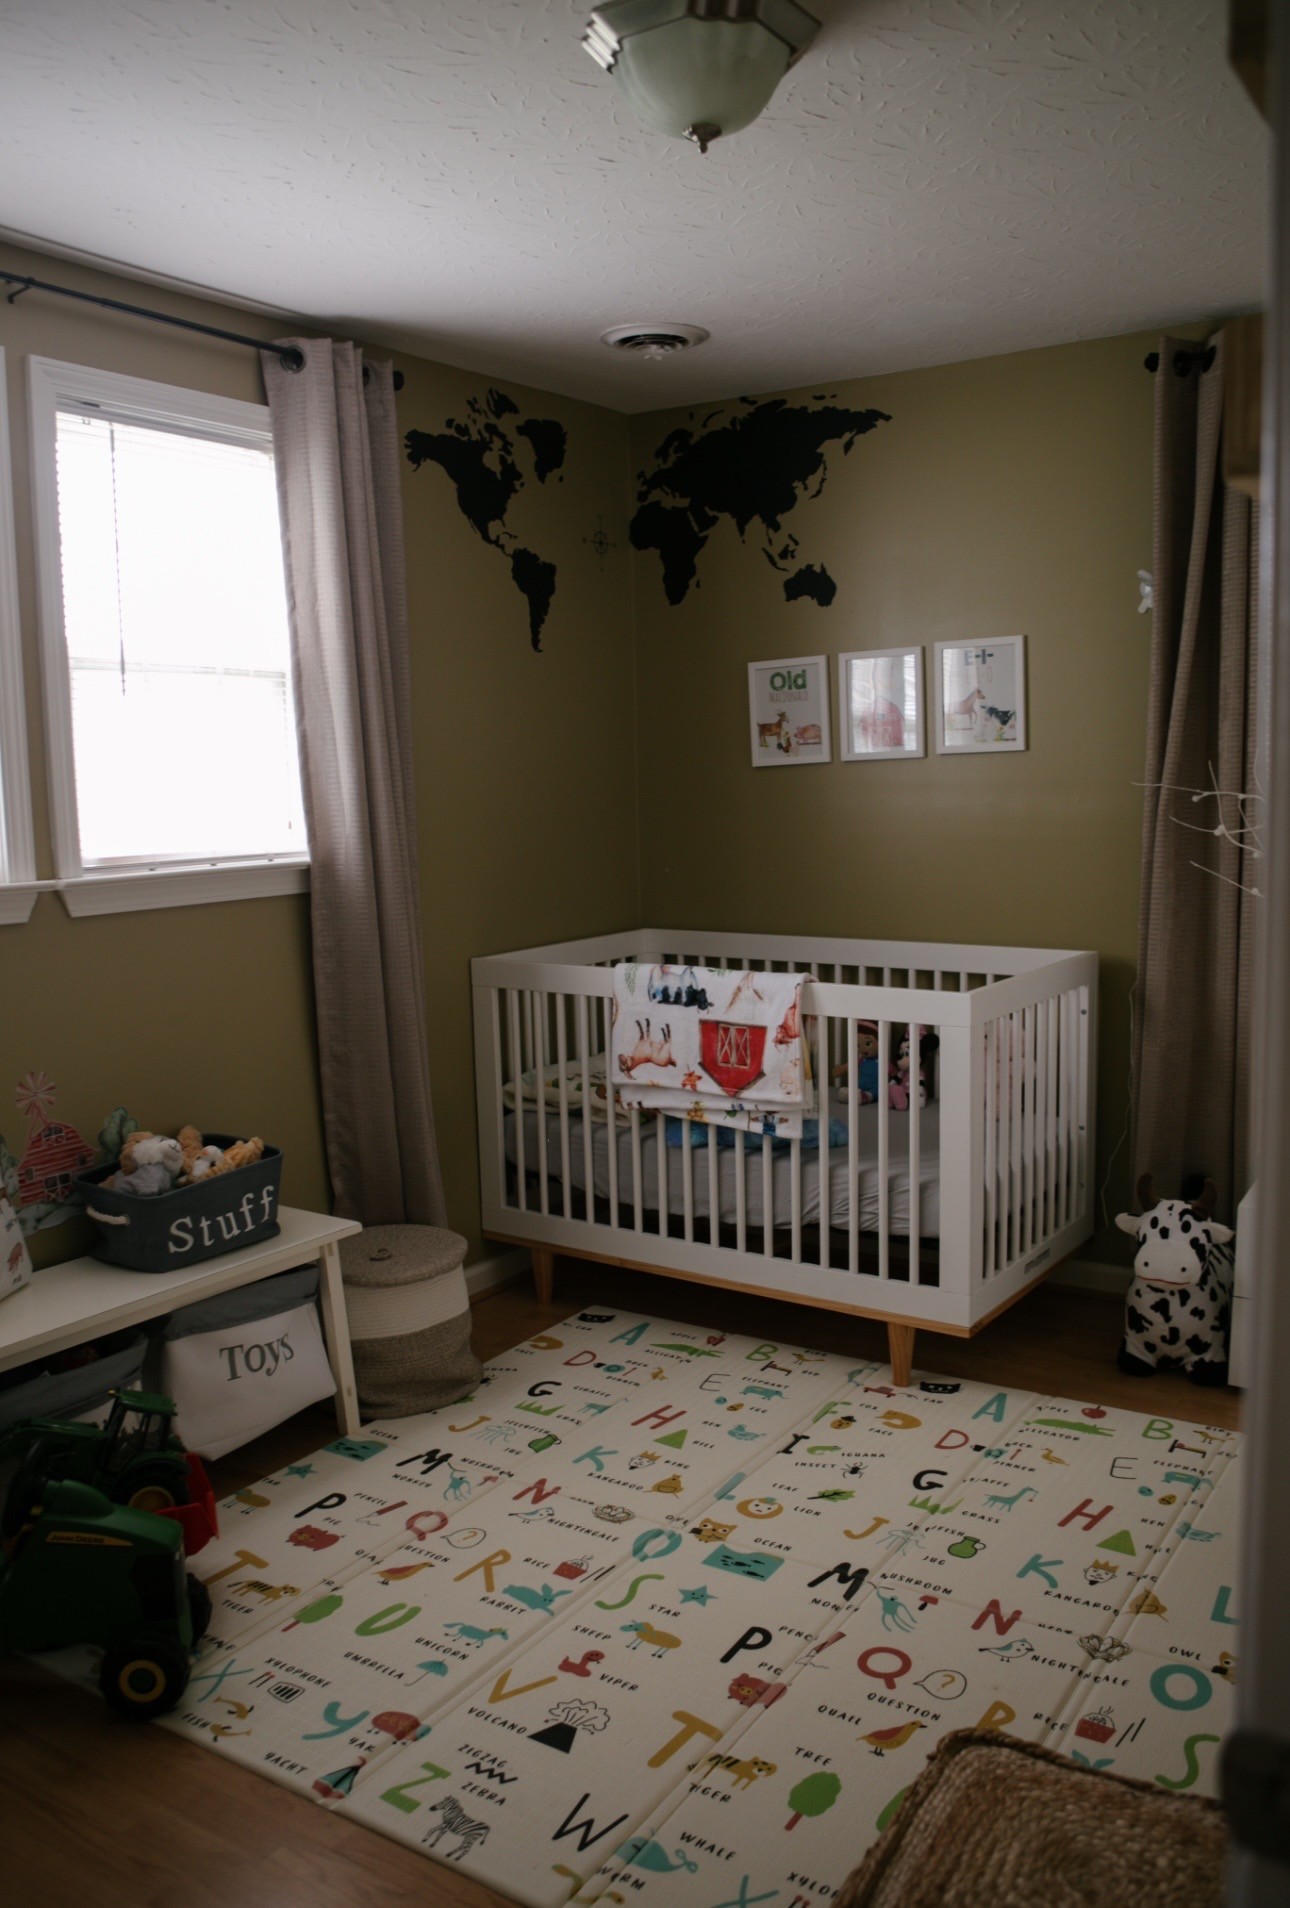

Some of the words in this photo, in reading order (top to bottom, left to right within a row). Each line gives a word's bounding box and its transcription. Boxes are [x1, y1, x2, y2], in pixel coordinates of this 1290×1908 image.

[770, 669, 807, 692] Old
[167, 1186, 275, 1254] Stuff
[609, 1322, 649, 1346] A
[563, 1351, 596, 1366] D
[746, 1344, 777, 1361] B
[528, 1381, 562, 1397] G
[700, 1373, 731, 1391] E
[631, 1405, 687, 1429] H
[972, 1393, 1007, 1422] A
[370, 1429, 399, 1439] OCEAN
[448, 1415, 491, 1432] J
[1142, 1419, 1174, 1440] B
[777, 1434, 809, 1454] I
[934, 1429, 969, 1449] D
[396, 1449, 453, 1474] M
[573, 1445, 618, 1472] K
[1110, 1457, 1138, 1479] E
[392, 1473, 432, 1488] MONKEY
[512, 1478, 561, 1504] N
[913, 1470, 948, 1490] G
[294, 1493, 346, 1518] P
[354, 1492, 387, 1505] PENCIL
[324, 1517, 341, 1525] PIG
[406, 1511, 448, 1541] Q
[962, 1511, 1000, 1524] GRASS
[1057, 1498, 1113, 1531] H
[1141, 1518, 1164, 1526] HEN
[548, 1519, 620, 1542] NIGHTINGALE
[844, 1517, 889, 1539] J
[754, 1537, 791, 1551] OCEAN
[202, 1550, 269, 1585] T
[454, 1549, 511, 1592] R
[523, 1557, 550, 1570] RICE
[923, 1556, 946, 1565] JUG
[1016, 1554, 1063, 1588] K
[594, 1574, 665, 1609] S
[807, 1562, 869, 1601] M
[222, 1600, 254, 1614] TIGER
[480, 1597, 527, 1615] RABBIT
[649, 1605, 681, 1617] STAR
[971, 1599, 1022, 1635] N
[1211, 1586, 1240, 1625] L
[355, 1603, 421, 1636] U
[572, 1625, 611, 1639] SHEEP
[415, 1637, 468, 1660] UNICORN
[720, 1627, 772, 1663] P
[1169, 1646, 1201, 1661] OWL
[265, 1657, 332, 1687] XYLOPHONE
[344, 1651, 405, 1680] UMBRELLA
[759, 1661, 783, 1675] PIG
[857, 1646, 912, 1690] Q
[190, 1658, 254, 1702] X
[488, 1668, 557, 1703] V
[599, 1674, 639, 1691] VIPER
[1150, 1664, 1212, 1711] O
[818, 1705, 862, 1725] QUAIL
[867, 1693, 941, 1721] QUESTION
[182, 1713, 210, 1729] FISH
[302, 1701, 369, 1740] Y
[467, 1707, 527, 1734] VOLCANO
[348, 1737, 375, 1752] YAK
[647, 1711, 723, 1768] T
[264, 1752, 308, 1774] YACHT
[458, 1744, 507, 1767] ZIGZAG
[796, 1747, 833, 1765] TREE
[1155, 1734, 1220, 1789] S
[380, 1761, 451, 1813] Z
[461, 1781, 506, 1805] ZEBRA
[552, 1793, 629, 1851] W
[680, 1832, 736, 1860] WHALE
